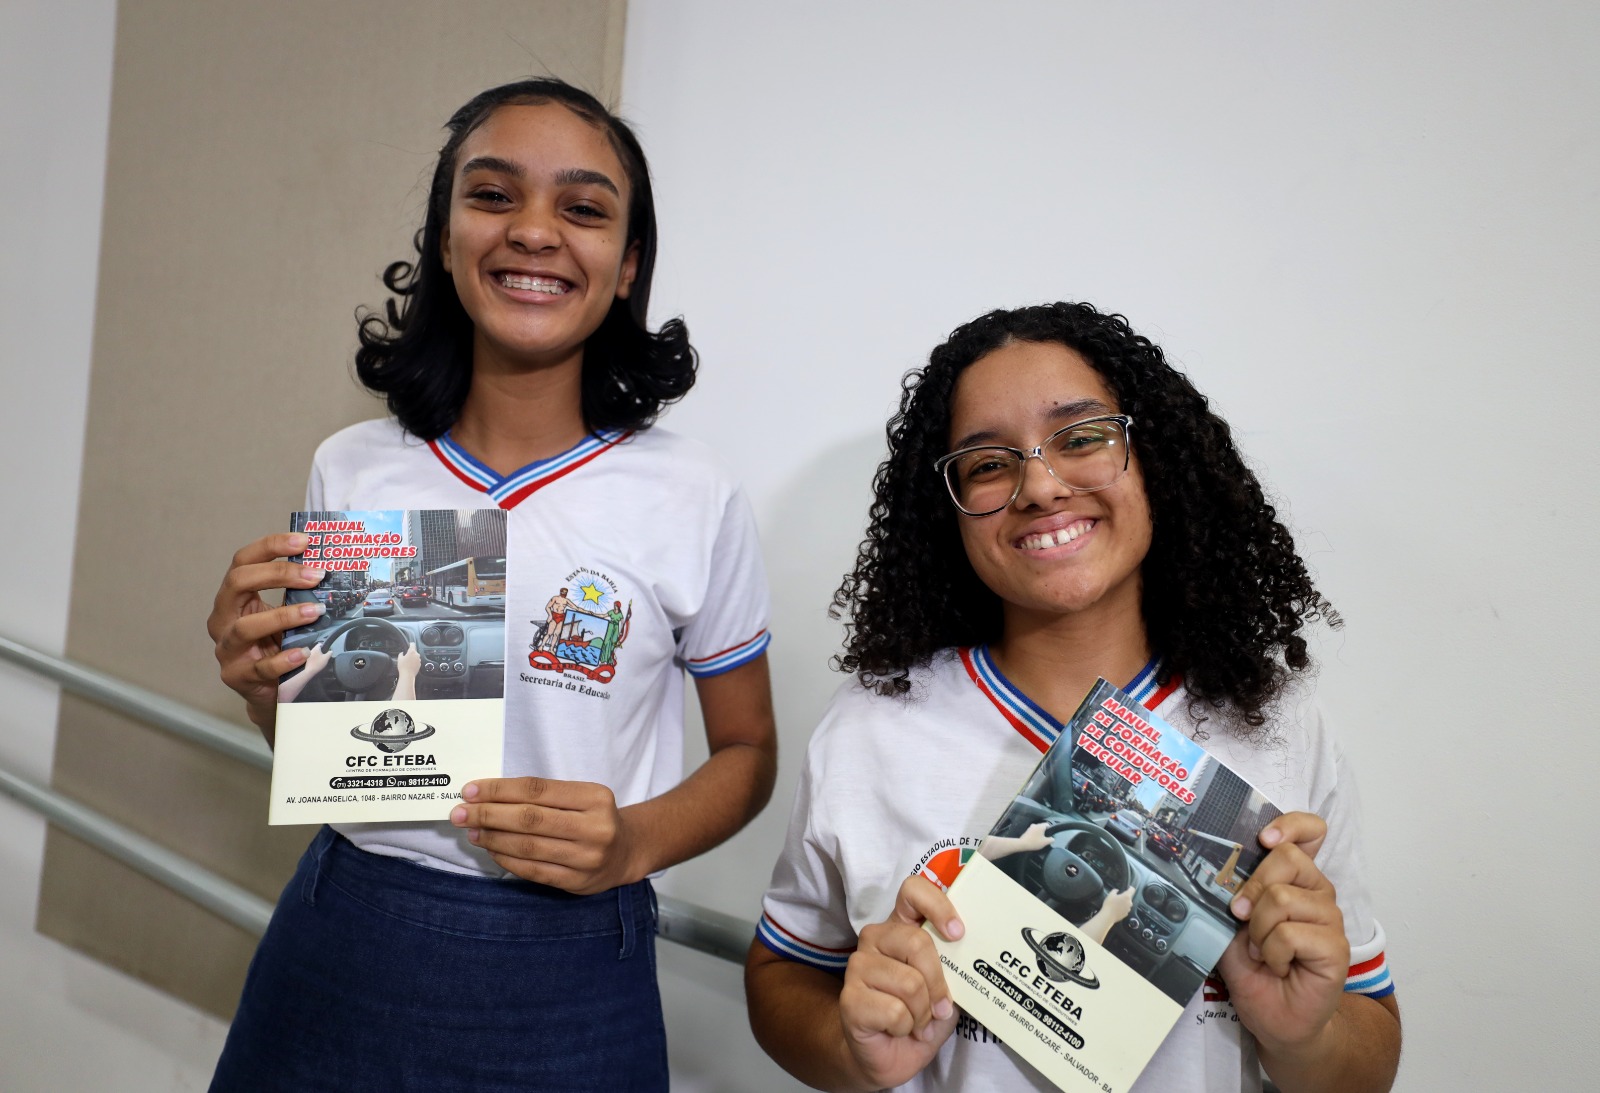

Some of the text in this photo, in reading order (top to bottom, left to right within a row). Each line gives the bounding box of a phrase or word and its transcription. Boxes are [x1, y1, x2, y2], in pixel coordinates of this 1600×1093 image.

[304, 521, 365, 532] MANUAL
[323, 532, 402, 547] FORMAÇÃO
[303, 546, 417, 559] DE CONDUTORES
[565, 566, 618, 594] ESTADO DA BAHIA
[519, 672, 563, 688] Secretaria
[565, 681, 576, 692] da
[563, 672, 586, 682] BRASIL
[1100, 697, 1162, 744] MANUAL
[1092, 710, 1188, 781] DE FORMAÇÃO
[346, 754, 437, 767] CFC ETEBA
[1076, 733, 1143, 787] VEICULAR
[1084, 723, 1197, 805] DE CONDUTORES
[347, 779, 384, 788] 3321-4318
[408, 777, 448, 786] 98112-4100
[297, 796, 321, 804] JOANA
[361, 794, 376, 802] 1048
[381, 793, 407, 801] BAIRRO
[408, 791, 435, 801] NAZARÉ
[440, 792, 463, 800] SALVA
[920, 838, 956, 864] ESTADUAL
[959, 837, 970, 845] DE
[999, 950, 1083, 1021] CFC ETEBA
[987, 972, 1023, 1002] 3321-4318
[1042, 1014, 1082, 1049] 98112-4100
[992, 996, 1007, 1010] 1048
[1009, 1009, 1035, 1032] BAIRRO
[1033, 1028, 1062, 1053] NAZARÉ
[1063, 1053, 1099, 1084] SALVADOR
[1101, 1083, 1113, 1093] BA
